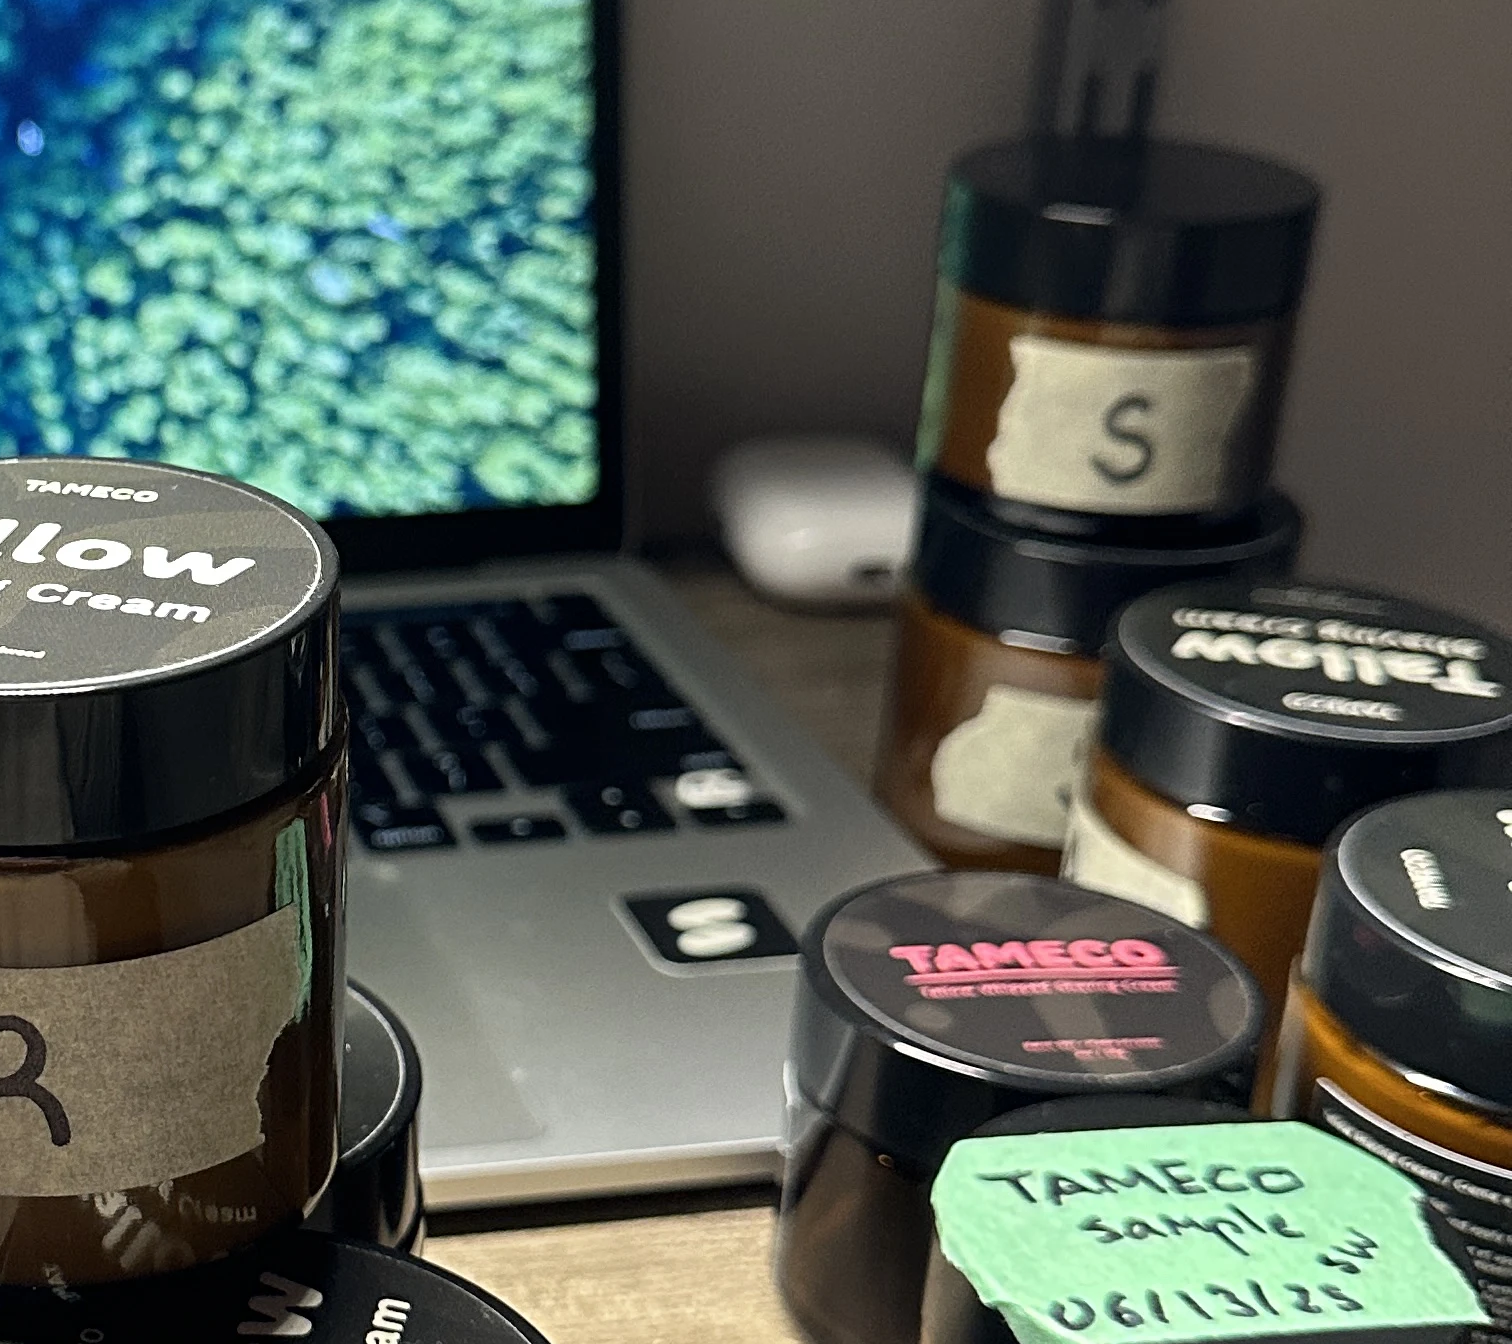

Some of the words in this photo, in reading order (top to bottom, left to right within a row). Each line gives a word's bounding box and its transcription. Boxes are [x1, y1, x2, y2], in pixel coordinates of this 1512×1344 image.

[1093, 396, 1155, 483] S
[26, 479, 158, 504] TAMECO
[26, 582, 213, 624] Cream
[1171, 630, 1505, 697] Tallow
[889, 939, 1168, 972] TAMECO
[975, 1158, 1305, 1205] TAMECO
[1078, 1203, 1305, 1256] sample
[1047, 1279, 1364, 1331] 06/13/25
